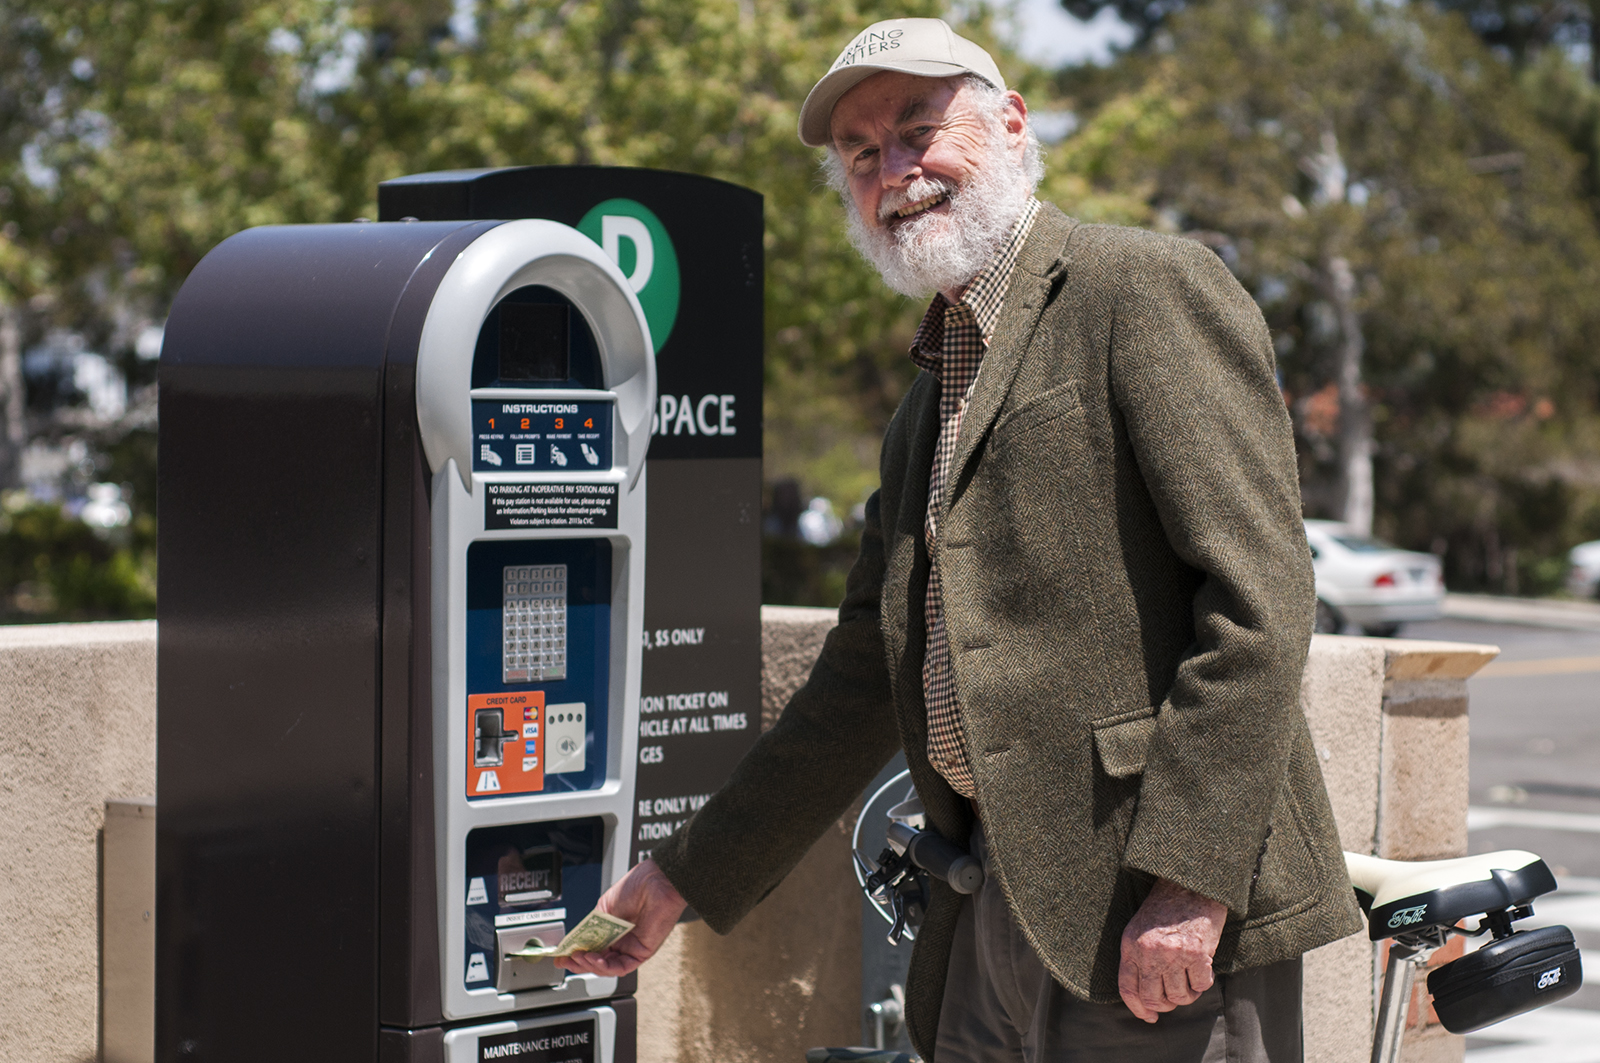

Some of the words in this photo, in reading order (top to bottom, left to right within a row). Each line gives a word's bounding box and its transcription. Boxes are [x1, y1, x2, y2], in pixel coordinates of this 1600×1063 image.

[844, 39, 900, 65] ATTERS
[502, 404, 579, 414] INSTRUCTIONS
[488, 418, 495, 429] 1
[520, 418, 530, 429] 2
[555, 418, 564, 429] 3
[584, 418, 593, 429] 4
[489, 485, 499, 494] NO
[499, 485, 522, 494] PARKING
[523, 485, 531, 493] AT
[531, 485, 564, 494] INOPERATIVE
[565, 485, 575, 493] PAY
[575, 485, 597, 493] STATION
[598, 485, 615, 494] AREAS
[580, 497, 595, 505] please
[595, 498, 605, 506] stop
[547, 506, 558, 514] kiosk
[566, 506, 589, 514] alternative
[529, 517, 544, 526] subject
[642, 630, 653, 650] 1,
[671, 627, 705, 646] ONLY
[486, 697, 509, 705] CREDIT
[510, 696, 527, 704] CARD
[641, 695, 664, 713] ION
[666, 692, 706, 711] TICKET
[708, 691, 728, 708] ON
[671, 717, 688, 735] AT
[689, 715, 711, 733] ALL
[712, 712, 748, 731] TIMES
[640, 746, 664, 764] GES
[638, 799, 652, 817] RE
[653, 795, 688, 815] ONLY
[500, 869, 550, 892] RECEIPT
[526, 912, 540, 920] CASH
[484, 1038, 549, 1060] MAINTENANCE
[551, 1032, 589, 1049] HOTLINE
